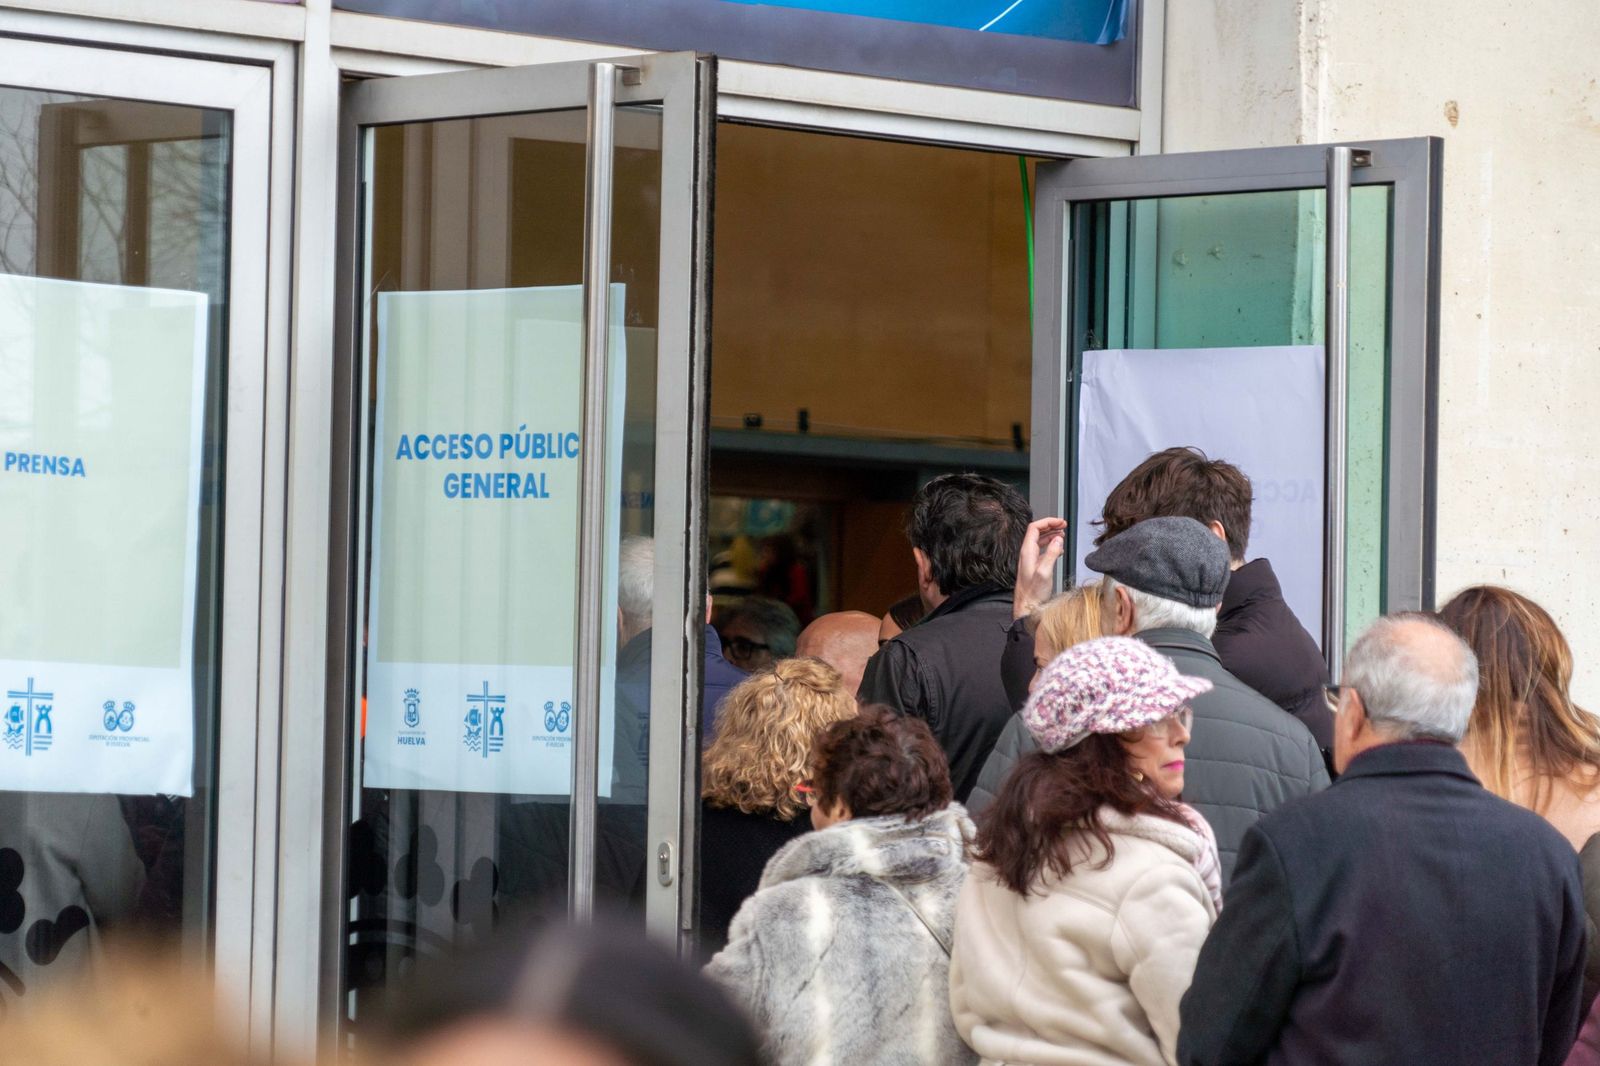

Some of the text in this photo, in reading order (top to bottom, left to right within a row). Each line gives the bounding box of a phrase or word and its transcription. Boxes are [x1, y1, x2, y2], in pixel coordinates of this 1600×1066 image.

[395, 424, 579, 460] ACCESO PÚBLIC
[4, 451, 86, 477] PRENSA
[443, 472, 550, 499] GENERAL
[397, 736, 426, 746] HUELVA
